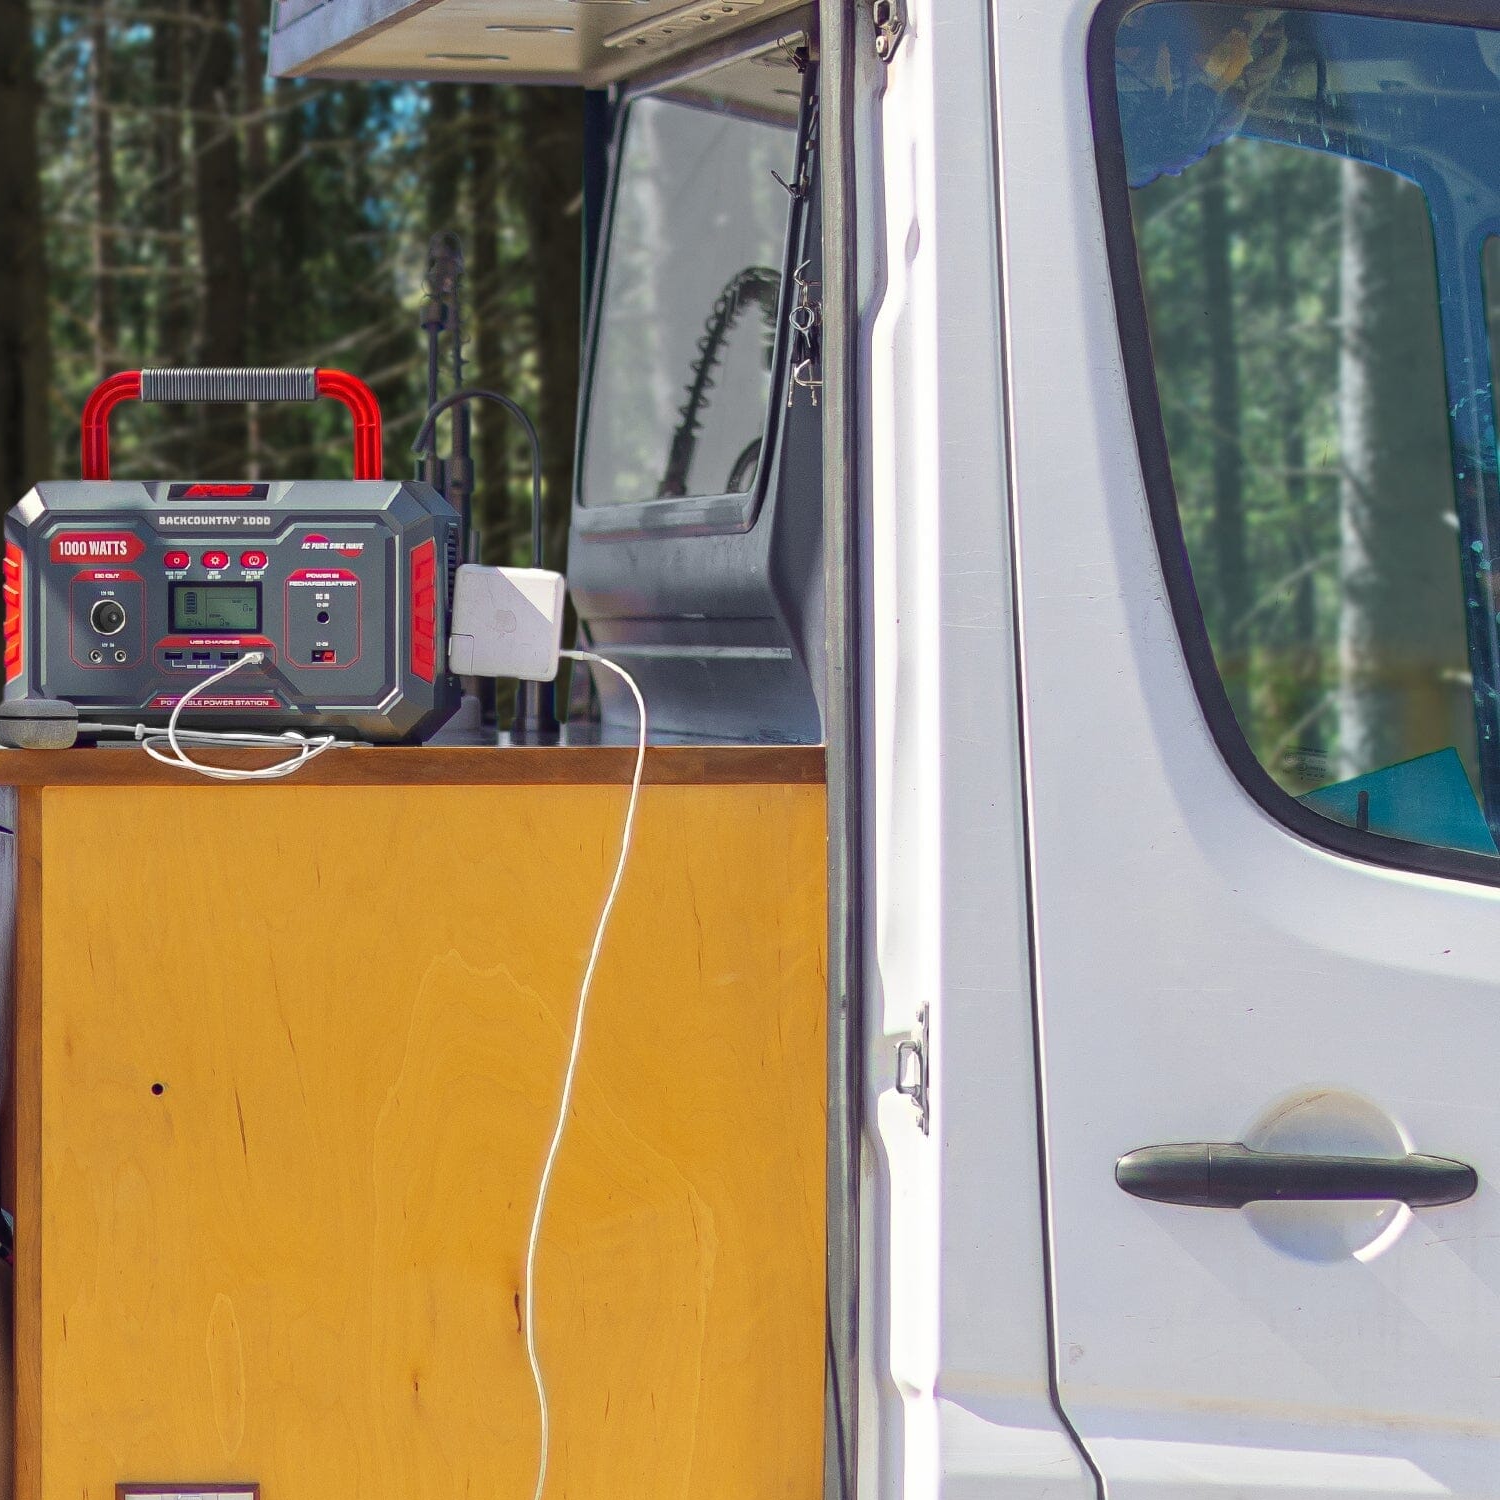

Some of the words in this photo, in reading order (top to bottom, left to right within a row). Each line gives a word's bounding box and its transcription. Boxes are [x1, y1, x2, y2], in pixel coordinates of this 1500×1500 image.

[243, 516, 271, 525] 1000
[59, 541, 87, 556] 1000
[89, 540, 128, 556] WATTS
[301, 542, 310, 550] AC
